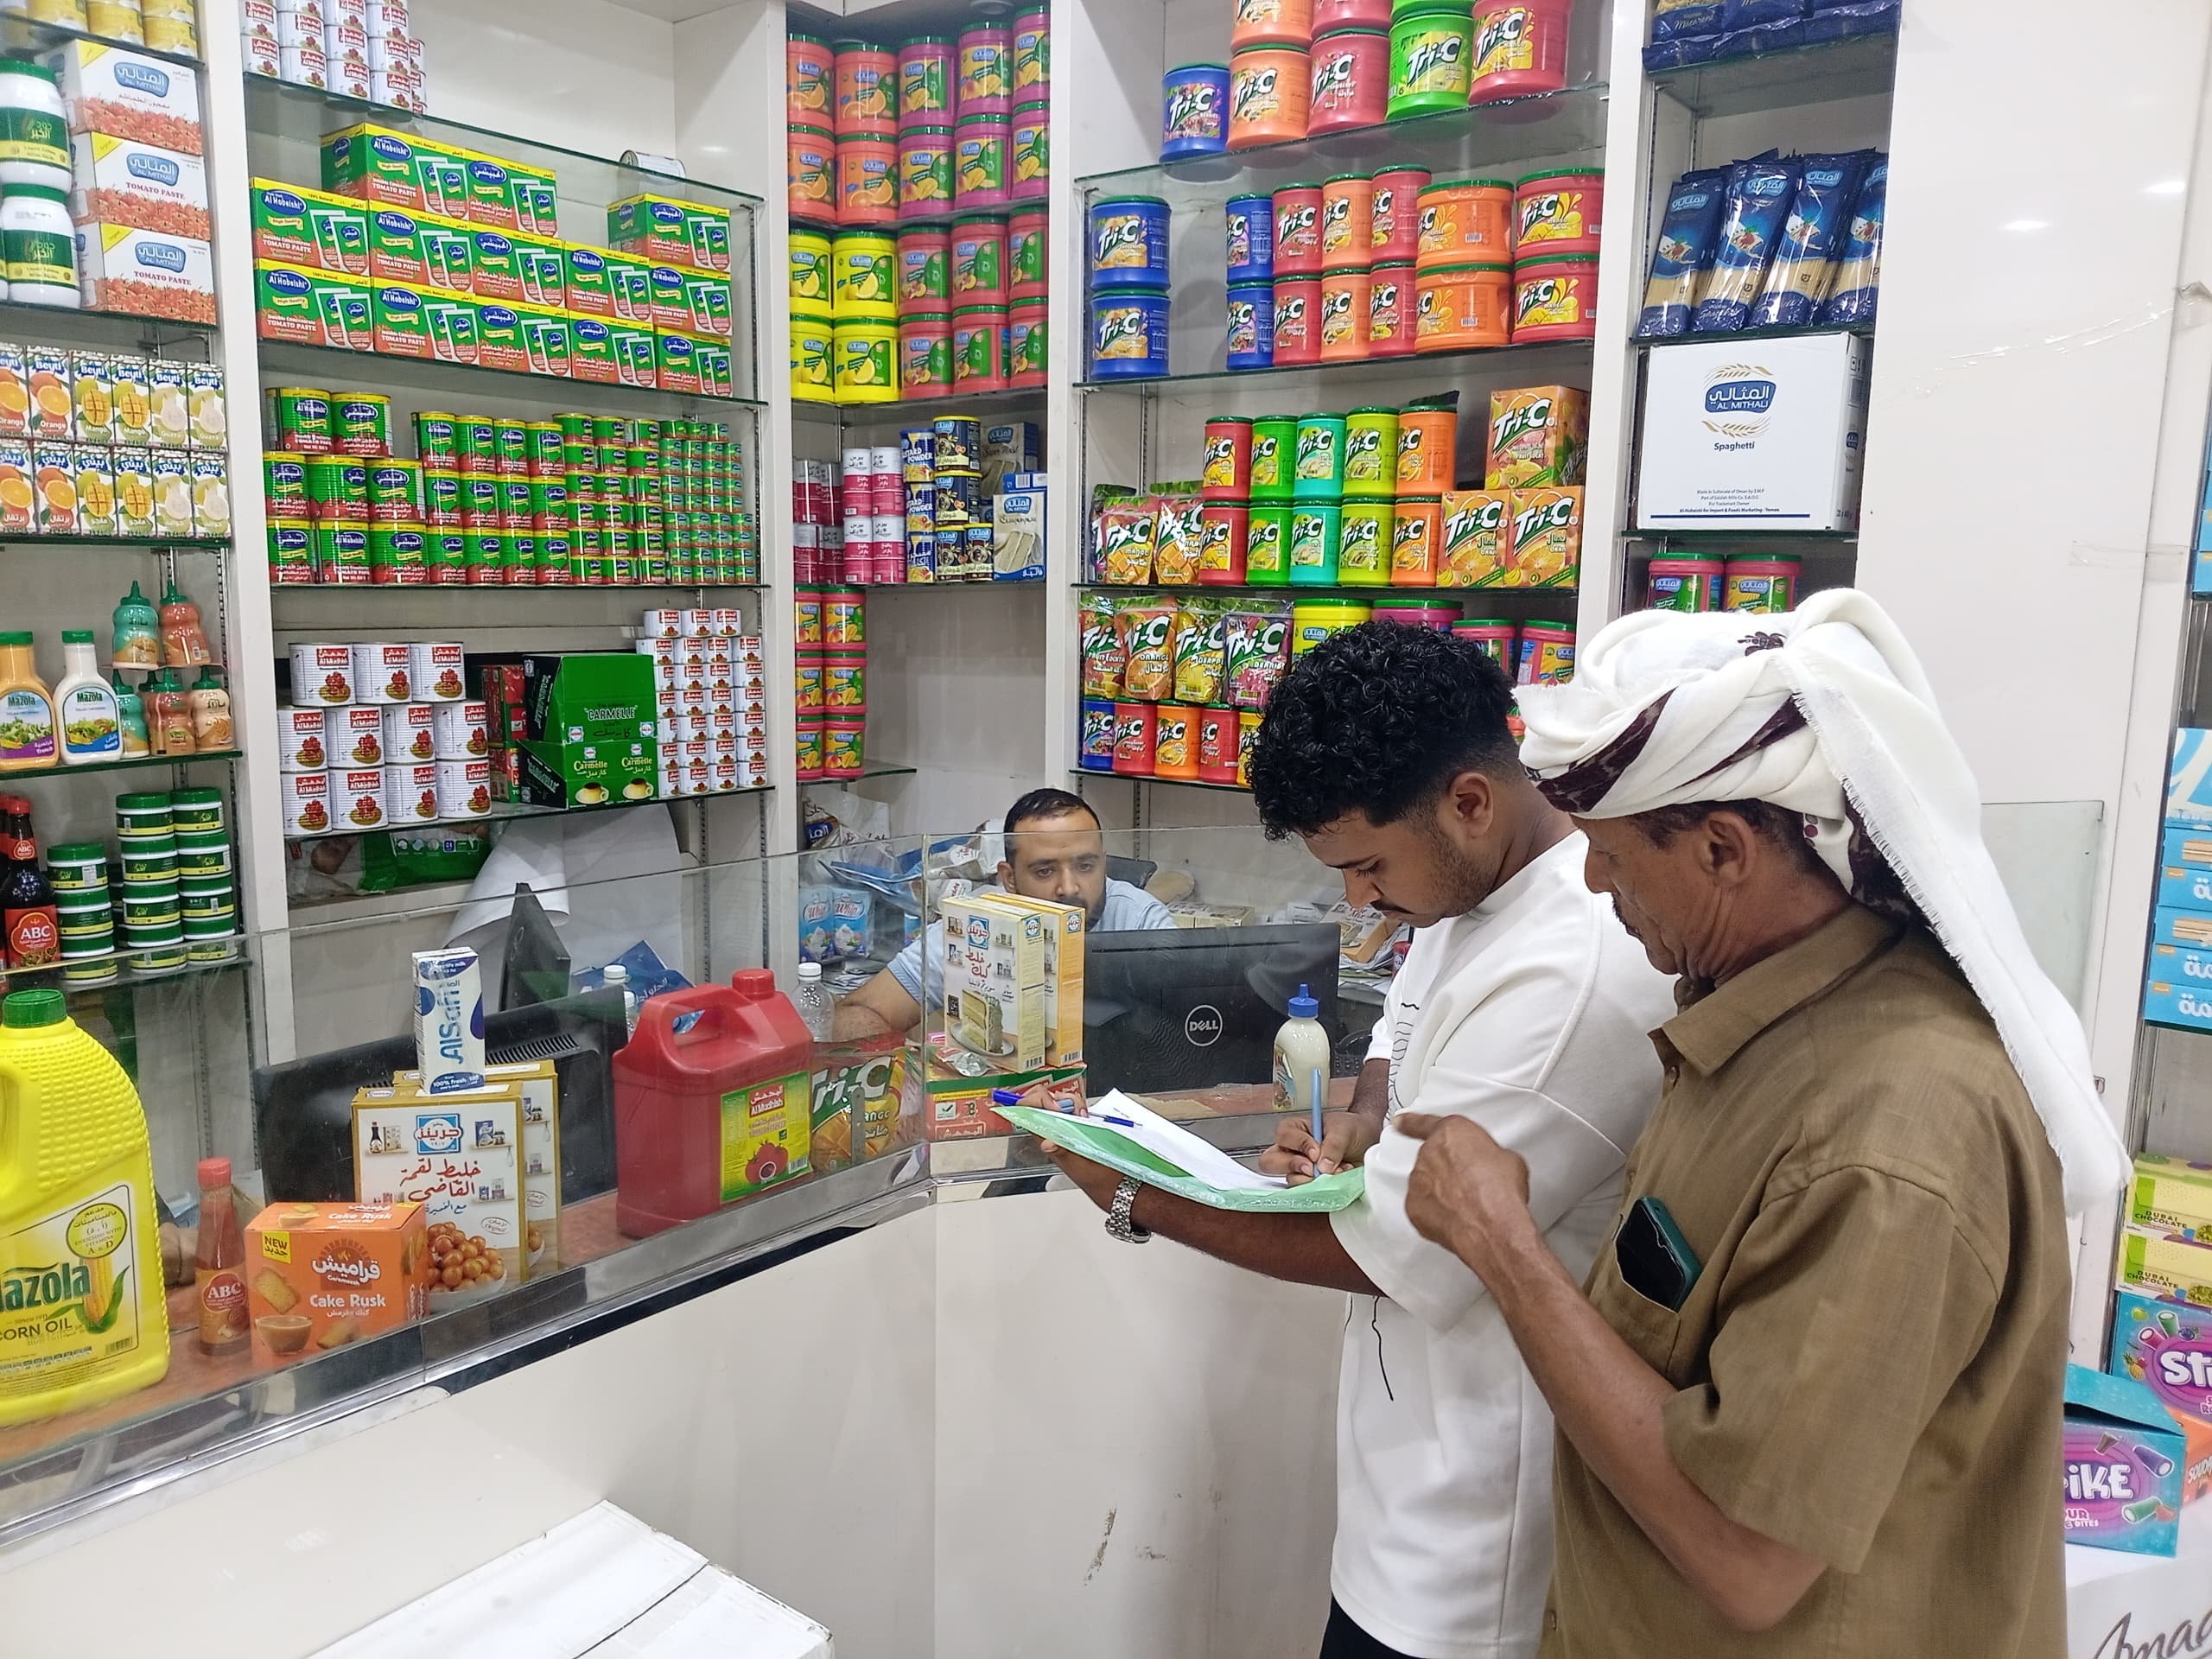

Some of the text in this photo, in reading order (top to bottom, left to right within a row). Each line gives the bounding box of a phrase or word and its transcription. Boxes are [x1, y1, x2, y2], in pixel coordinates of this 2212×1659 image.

[1473, 12, 1526, 69] Tri-C
[1407, 36, 1462, 87] Tri-C
[1232, 68, 1278, 119] Tri-C
[1168, 86, 1216, 131] Tri-C
[126, 182, 185, 199] TOMATO PASTE
[1518, 194, 1560, 240] Tri-C
[1277, 207, 1317, 245] Tri-C
[1097, 219, 1141, 262] Tri-C
[134, 270, 191, 285] TOMATO PASTE
[1516, 278, 1557, 323] Tri-C
[1098, 311, 1141, 353] Tri-C
[1708, 385, 1770, 404] المثالي
[1716, 400, 1770, 410] AL MITHALI
[40, 421, 67, 429] Orange
[1491, 397, 1553, 461] Tri-C
[1713, 442, 1755, 451] Spaghetti
[3, 514, 25, 523] برتقال
[49, 514, 70, 523] برتقال
[1514, 497, 1575, 556] Tri-C
[1445, 501, 1504, 556] Tri-C
[1226, 622, 1287, 669] Tri-C
[8, 696, 35, 706] Mazola
[77, 692, 103, 702] Mazola
[574, 760, 608, 772] Carmelle
[622, 757, 652, 767] Carmelle
[20, 925, 50, 940] ABC
[1188, 1018, 1219, 1033] DELL
[417, 1128, 460, 1141] جرينز
[436, 1158, 481, 1178] خليط
[454, 1205, 467, 1214] مع
[2145, 1210, 2178, 1221] DUBAI
[2135, 1213, 2188, 1229] CHOCOLATE
[105, 1240, 114, 1249] D
[264, 1236, 287, 1249] NEW
[264, 1246, 288, 1257] جديد
[311, 1255, 381, 1283] قراميش
[2138, 1269, 2171, 1282] DUBAI
[2126, 1272, 2179, 1289] CHOCOLATE
[207, 1283, 241, 1299] ABC
[309, 1294, 386, 1307] Cake Rusk
[0, 1318, 73, 1342] ORN OIL
[2064, 1464, 2134, 1500] iKE
